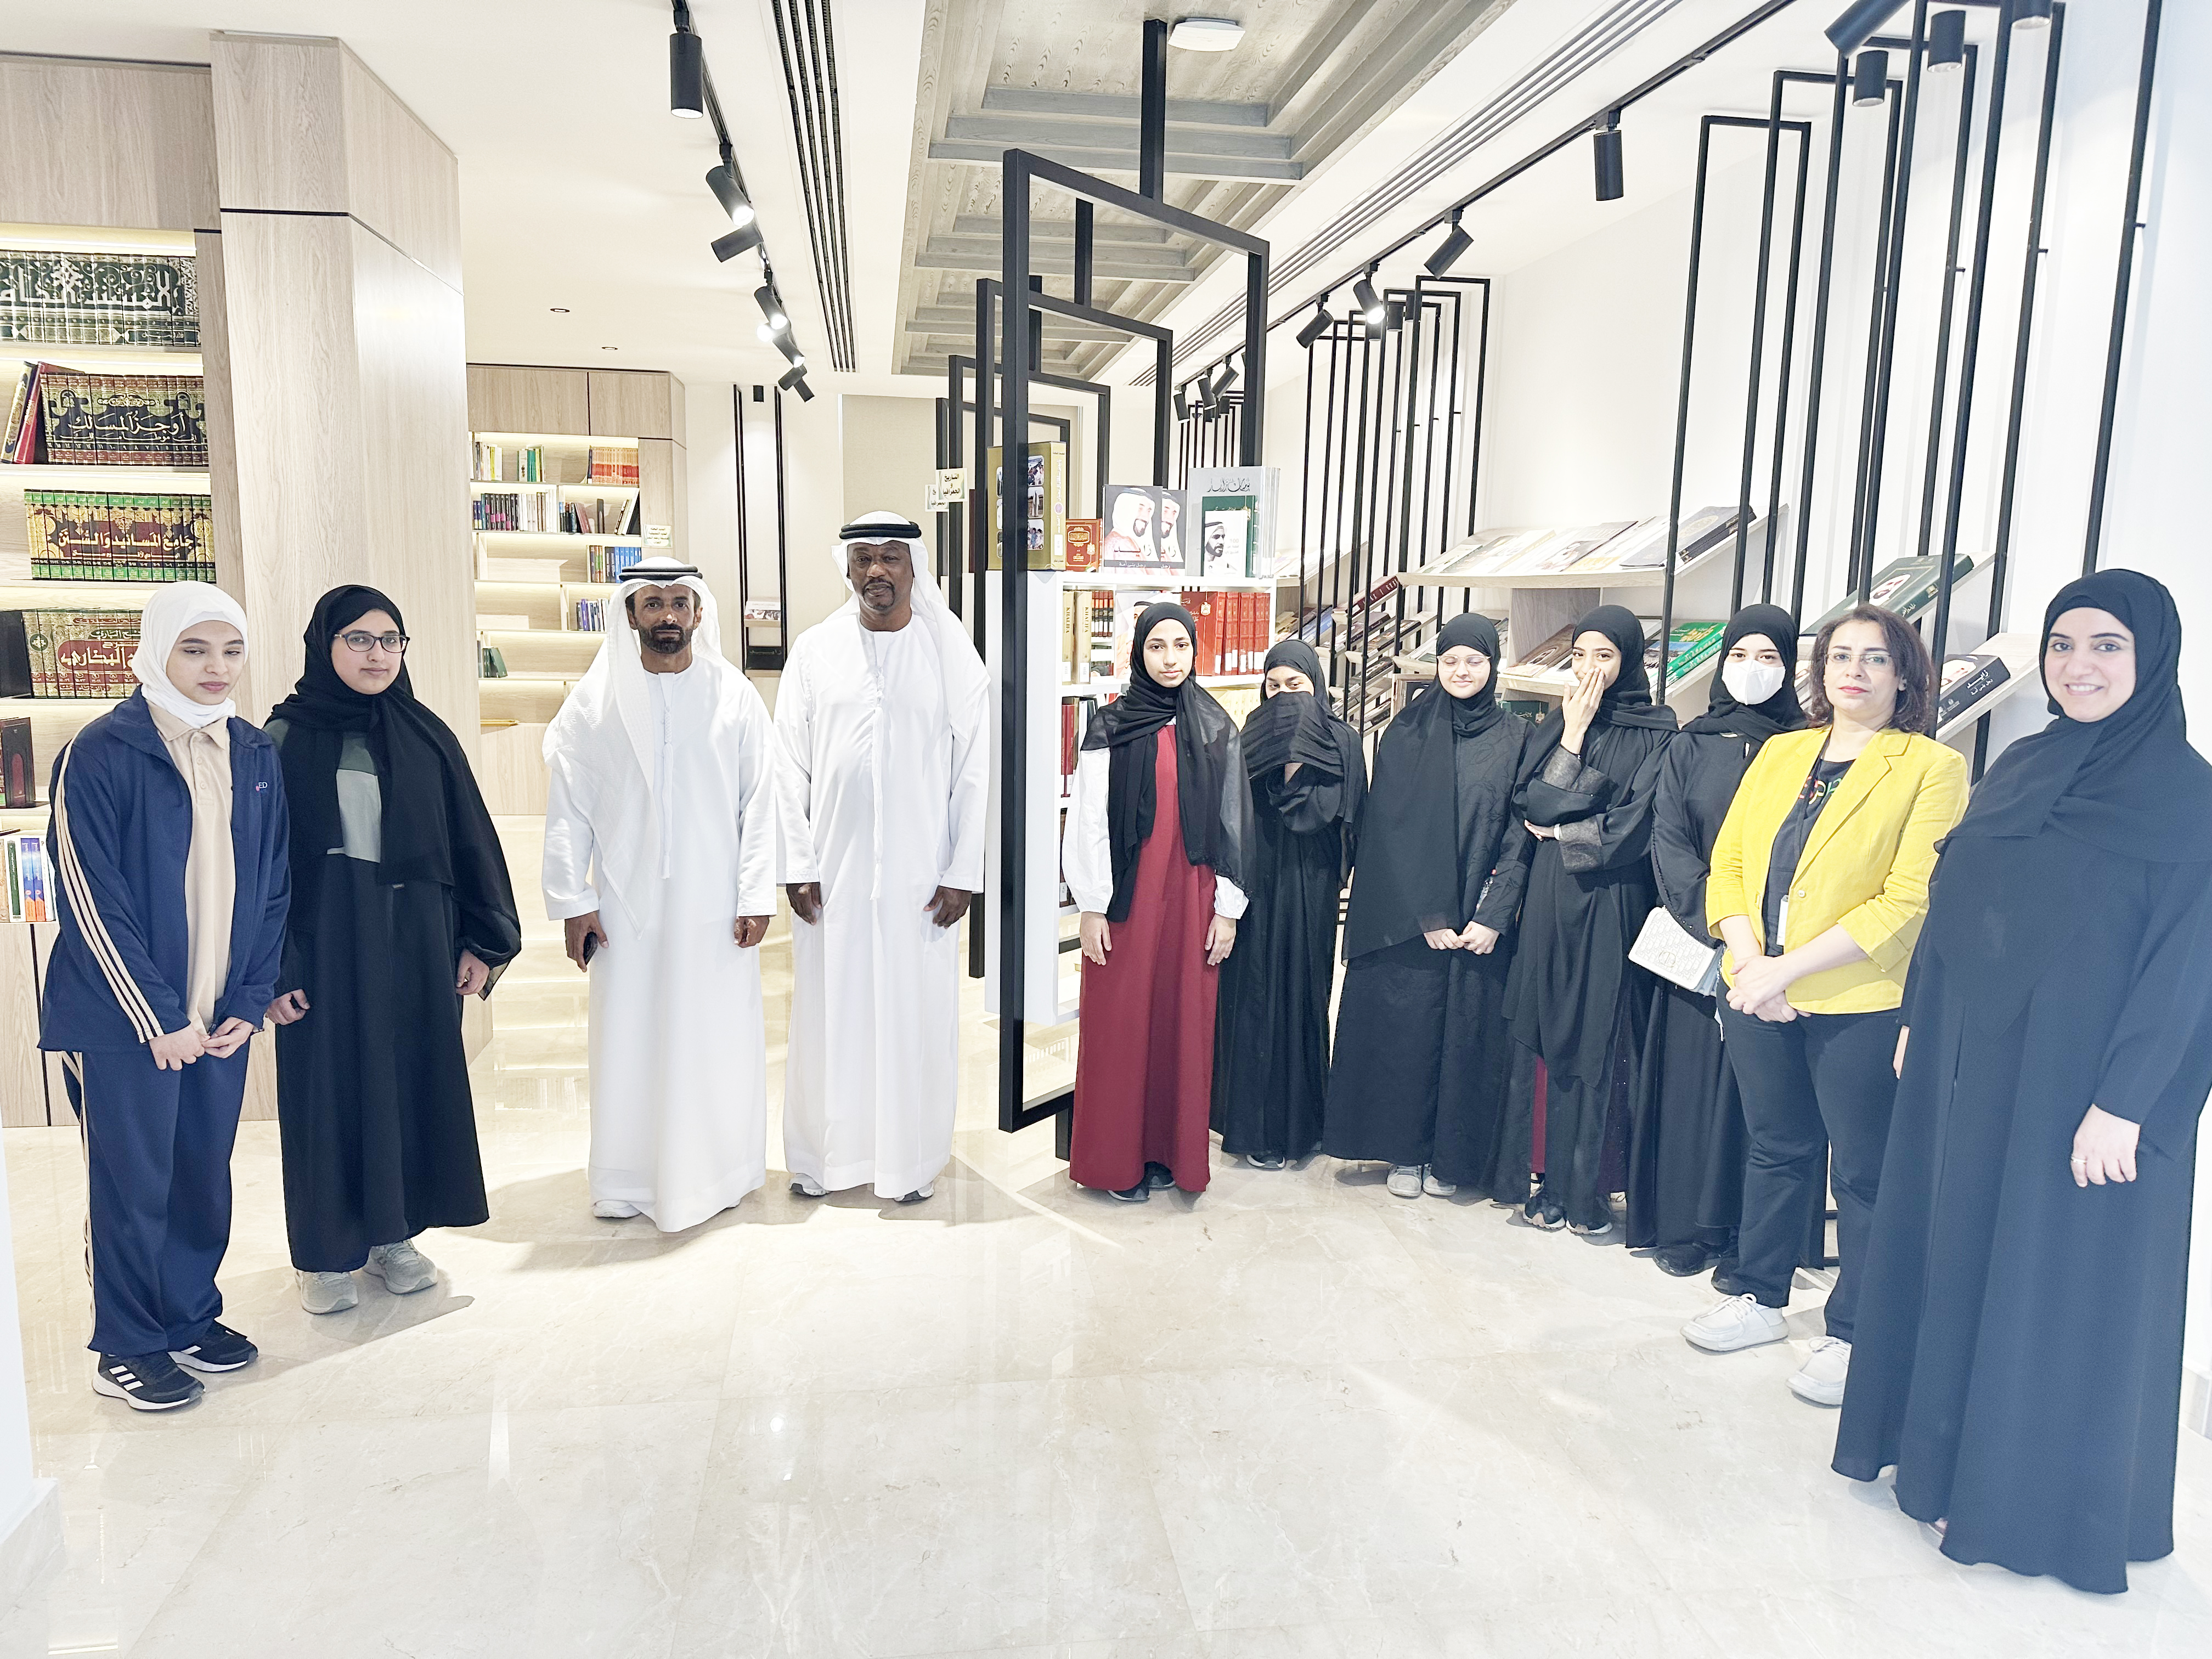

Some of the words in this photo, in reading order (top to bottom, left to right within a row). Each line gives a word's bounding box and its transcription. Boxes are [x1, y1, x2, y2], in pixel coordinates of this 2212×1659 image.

[945, 473, 959, 482] التاريخ
[1114, 544, 1152, 557] زايد
[1161, 545, 1176, 557] زاي
[61, 646, 126, 669] البخاري
[1967, 669, 1989, 689] زايد
